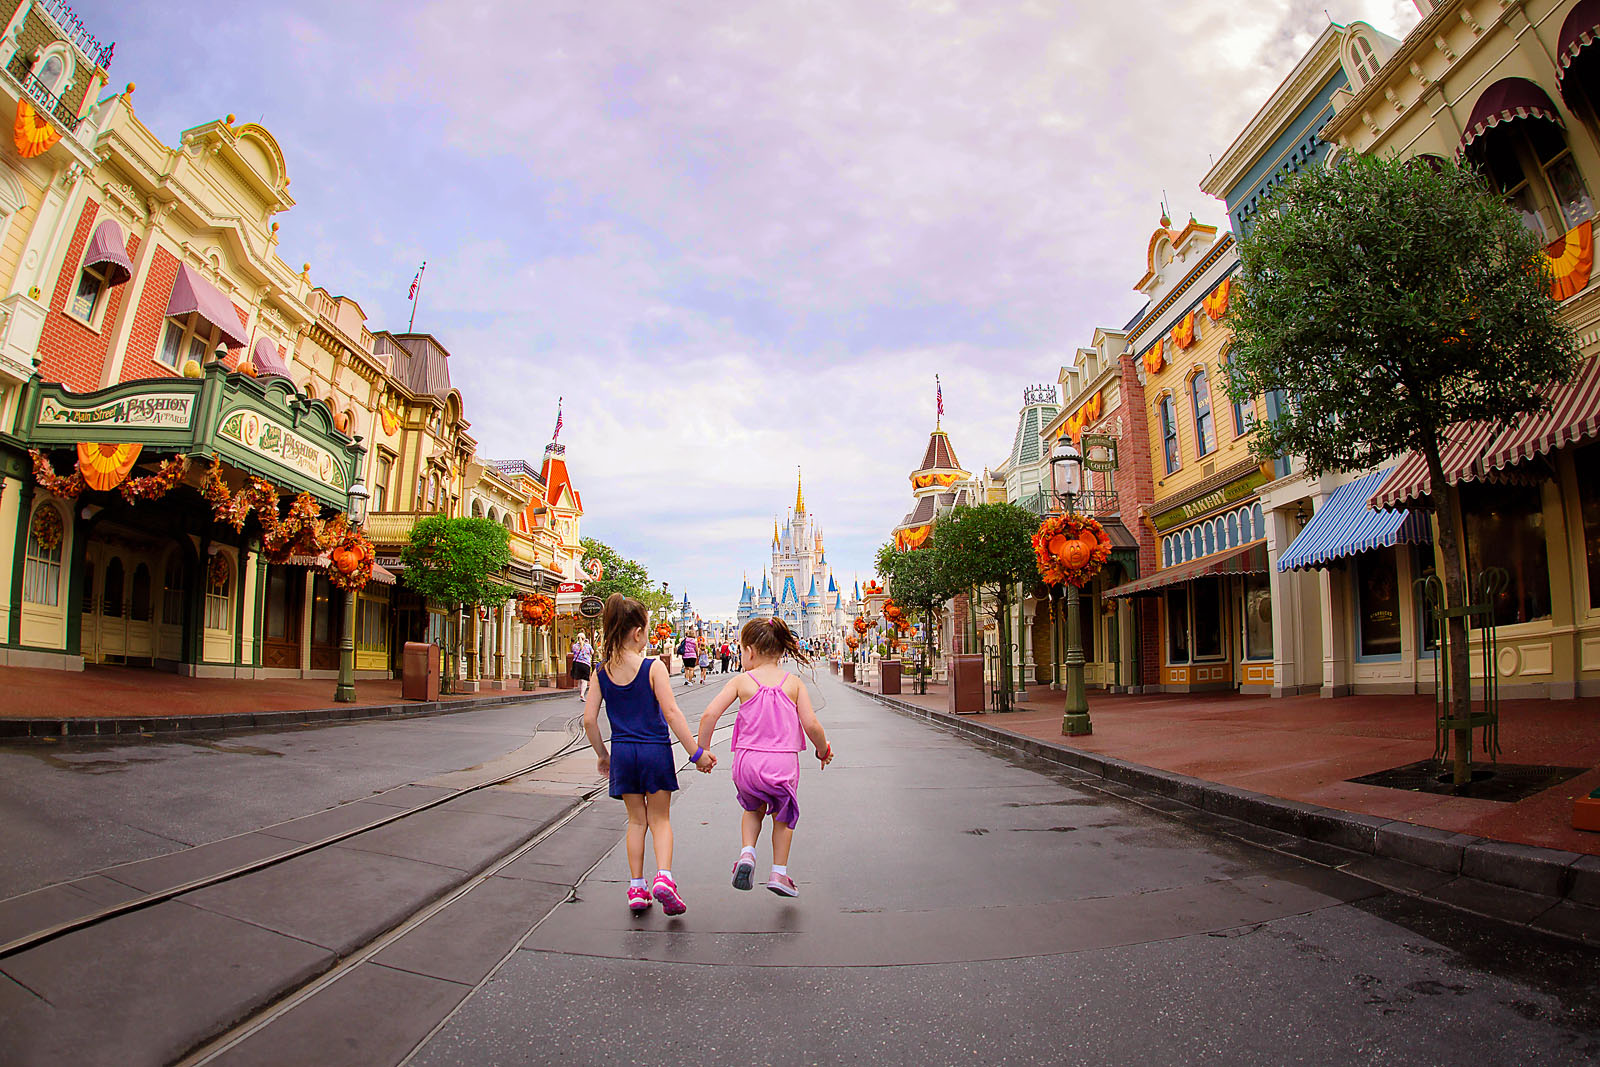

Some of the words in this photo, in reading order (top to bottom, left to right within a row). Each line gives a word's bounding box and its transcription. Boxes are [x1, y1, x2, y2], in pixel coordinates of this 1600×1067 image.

[74, 411, 91, 424] Main
[92, 405, 117, 421] Street
[123, 398, 190, 424] FASHION
[152, 412, 190, 424] APPAREL
[279, 432, 320, 461] FASHION
[1090, 462, 1113, 470] COFFEE
[1181, 488, 1228, 519] BAKERY
